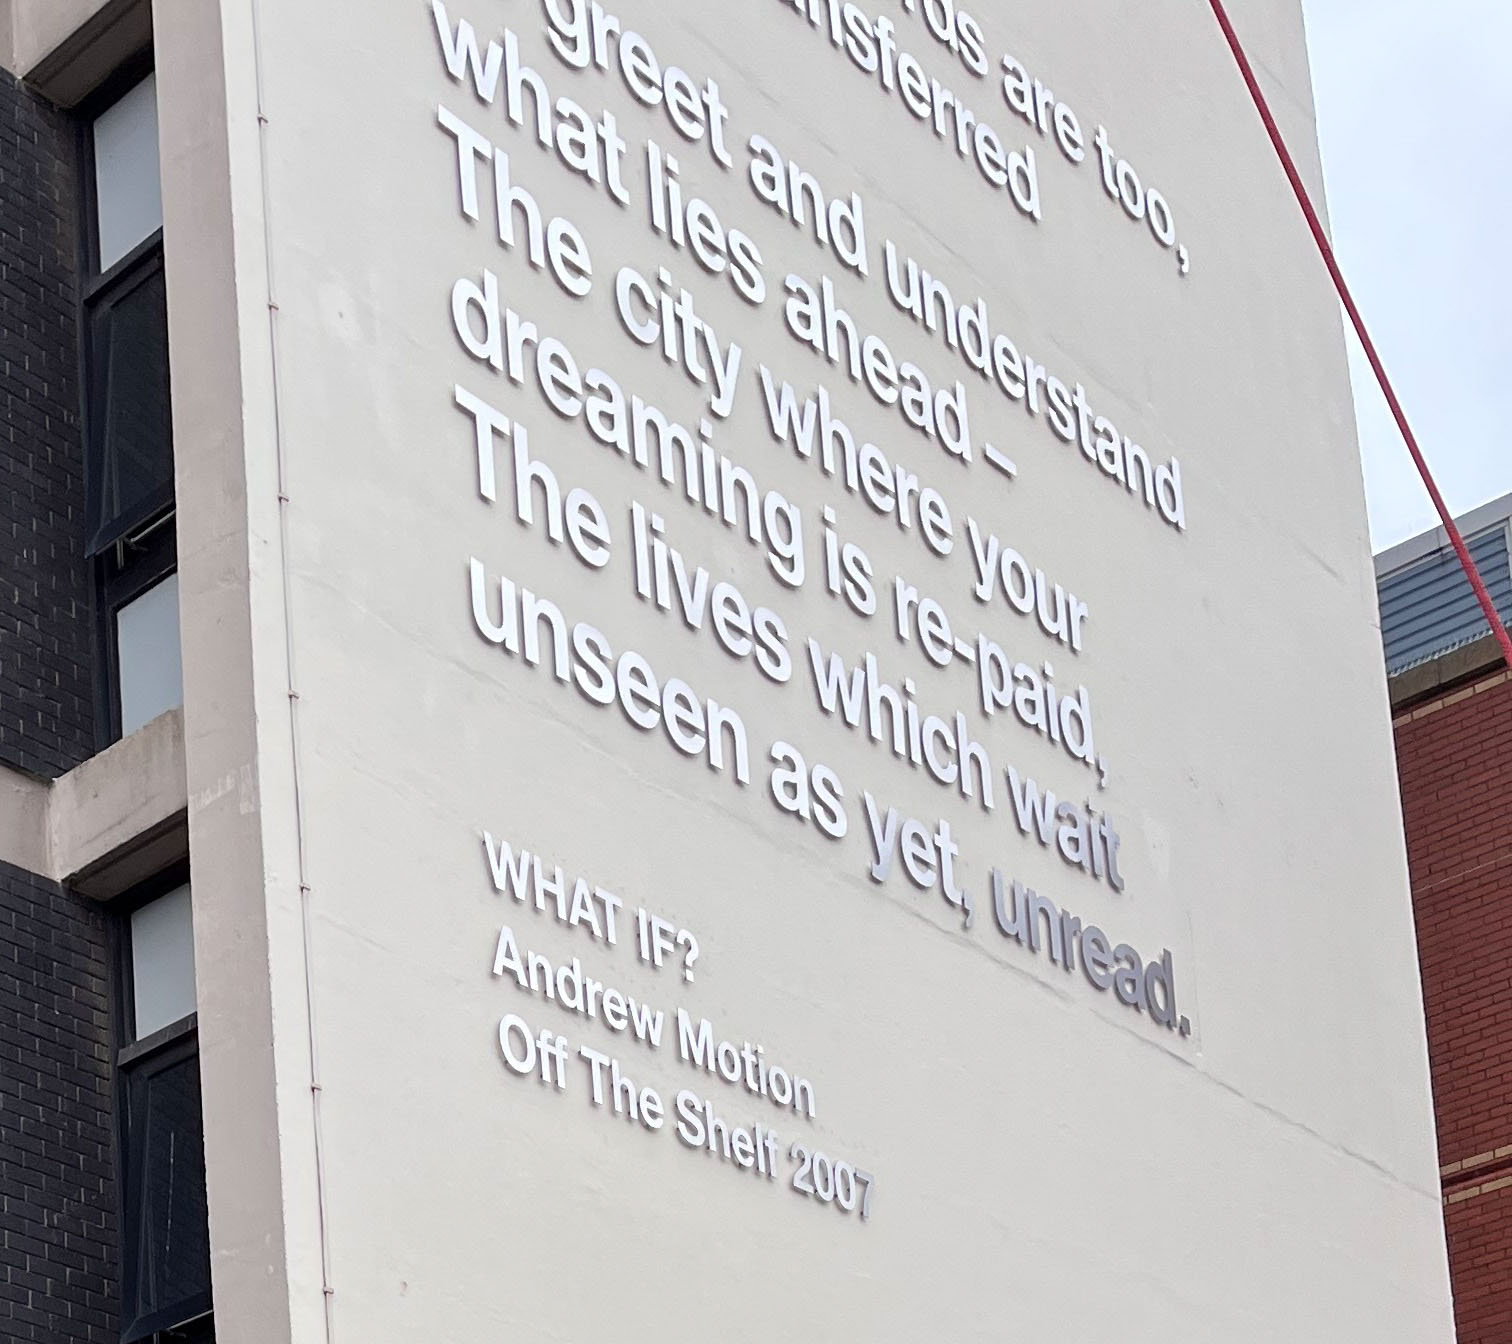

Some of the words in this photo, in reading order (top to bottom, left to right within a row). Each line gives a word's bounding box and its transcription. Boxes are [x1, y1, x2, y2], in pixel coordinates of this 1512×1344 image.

[432, 0, 631, 206] what
[646, 139, 767, 305] lies
[784, 273, 973, 465] ahead
[546, 0, 733, 169] greet
[747, 135, 869, 277] and
[884, 239, 1188, 531] understand
[785, 0, 1042, 220] nsferred
[1003, 53, 1087, 165] are
[1094, 125, 1191, 275] too,
[437, 103, 593, 296] The
[616, 266, 742, 419] city
[759, 364, 955, 555] where
[966, 515, 1088, 652] your
[451, 268, 805, 588] dreaming
[823, 504, 877, 616] is
[894, 574, 1110, 789] re-paid,
[454, 384, 612, 569] The
[631, 499, 793, 683] lives
[808, 637, 995, 809] which
[1007, 765, 1125, 892] wait
[469, 556, 750, 785] unseen
[771, 740, 849, 839] as
[861, 790, 976, 929] yet,
[993, 867, 1192, 1037] unread.
[483, 830, 623, 947] WHAT
[637, 906, 700, 984] IF?
[491, 925, 664, 1048] Andrew
[678, 1008, 816, 1119] Motion
[498, 1012, 569, 1089] Off
[580, 1046, 665, 1130] The
[676, 1089, 778, 1175] Shelf
[789, 1143, 875, 1219] 2007
